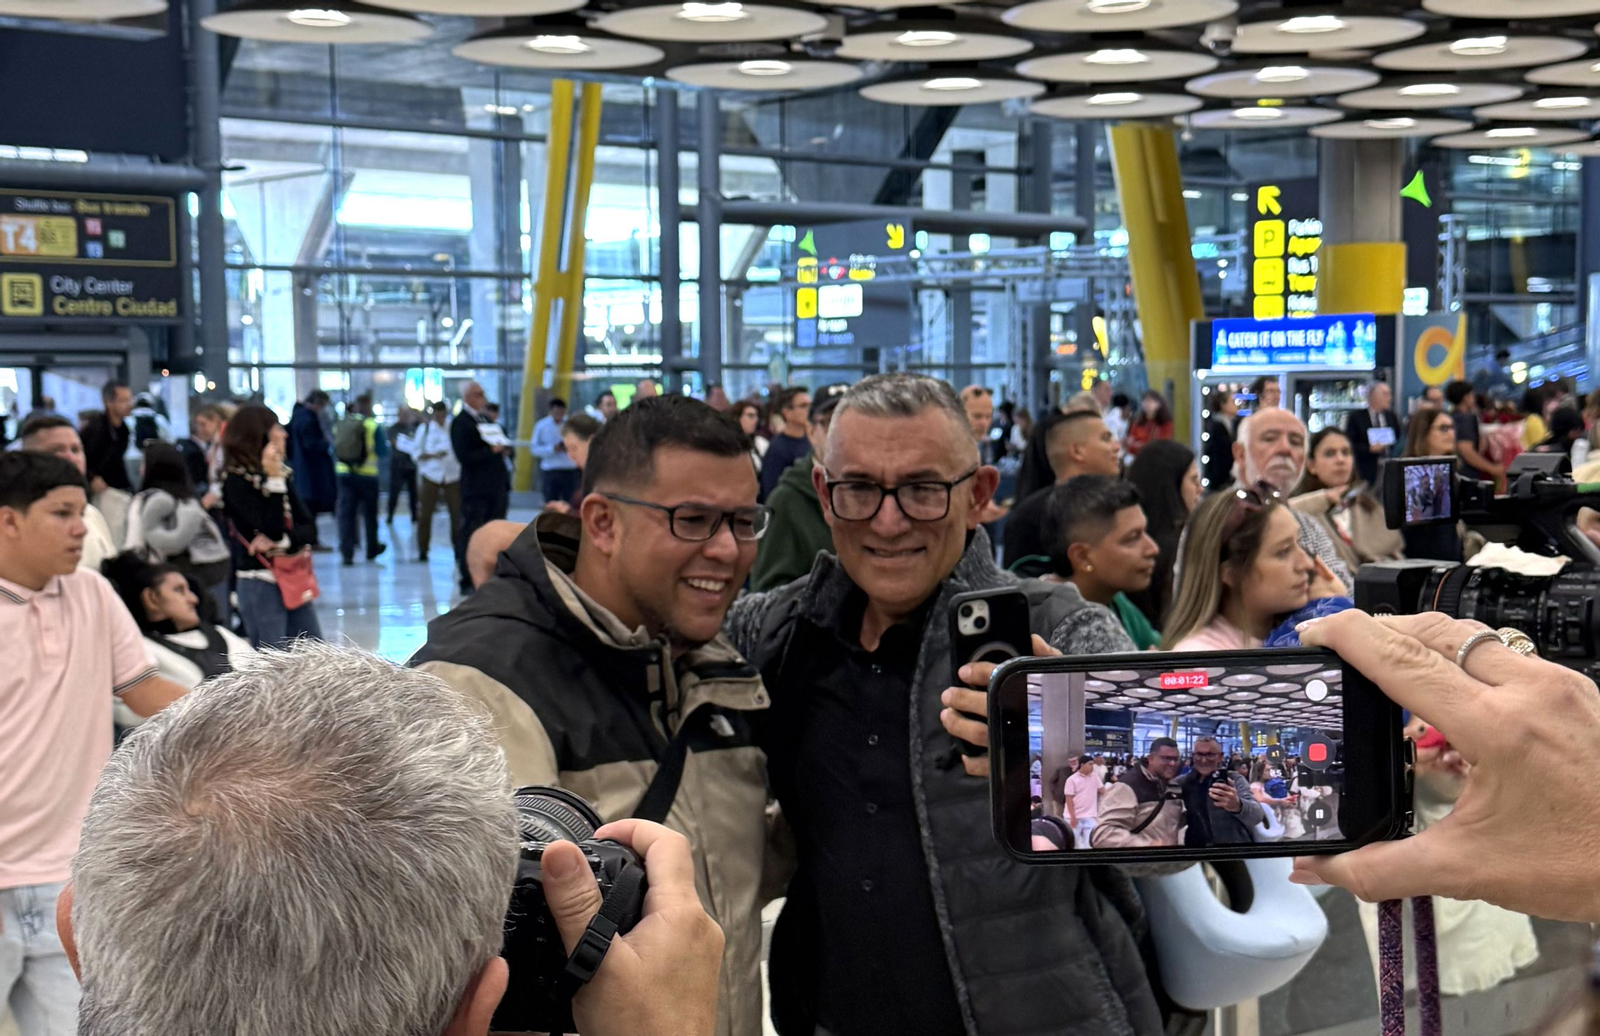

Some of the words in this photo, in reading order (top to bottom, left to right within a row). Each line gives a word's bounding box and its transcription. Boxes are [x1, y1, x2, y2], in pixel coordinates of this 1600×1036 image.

[1, 221, 38, 254] T4
[51, 275, 81, 297] City
[83, 276, 134, 295] Center
[52, 295, 114, 316] Centro
[115, 297, 178, 316] Ciudad
[1228, 331, 1258, 349] CATCH
[1259, 331, 1270, 348] IT
[1271, 330, 1286, 348] ON
[1287, 329, 1305, 347] THE
[1306, 329, 1325, 347] FLY
[1163, 675, 1205, 686] 00:01:22
